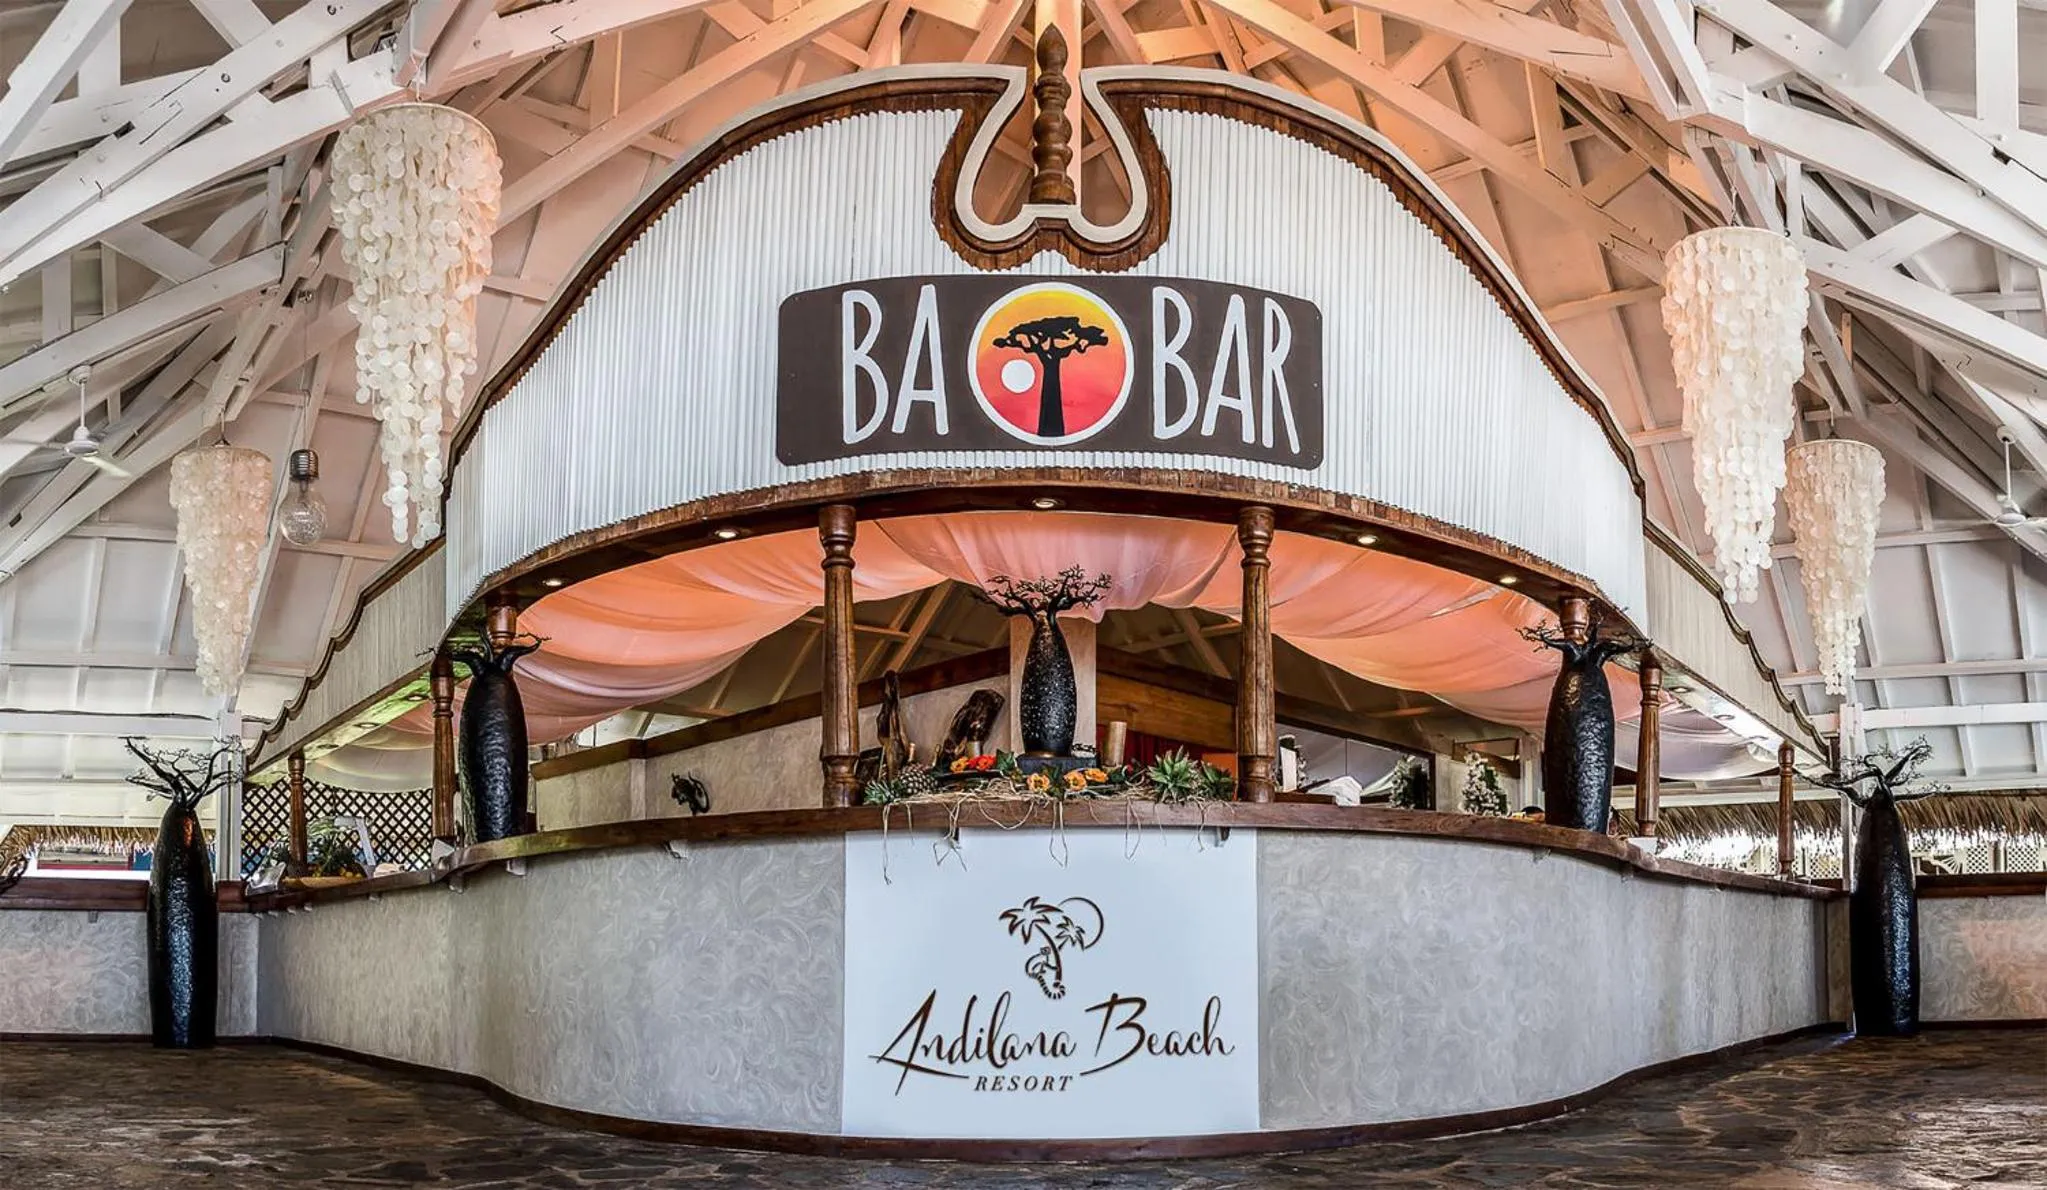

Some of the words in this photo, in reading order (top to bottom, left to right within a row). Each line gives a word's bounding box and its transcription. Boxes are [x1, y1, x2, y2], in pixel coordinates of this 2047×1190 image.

[842, 284, 948, 444] BA
[1152, 286, 1301, 454] BAR
[868, 989, 1078, 1096] Andilana
[1079, 993, 1236, 1077] Beach
[974, 1075, 1074, 1092] RESORT
